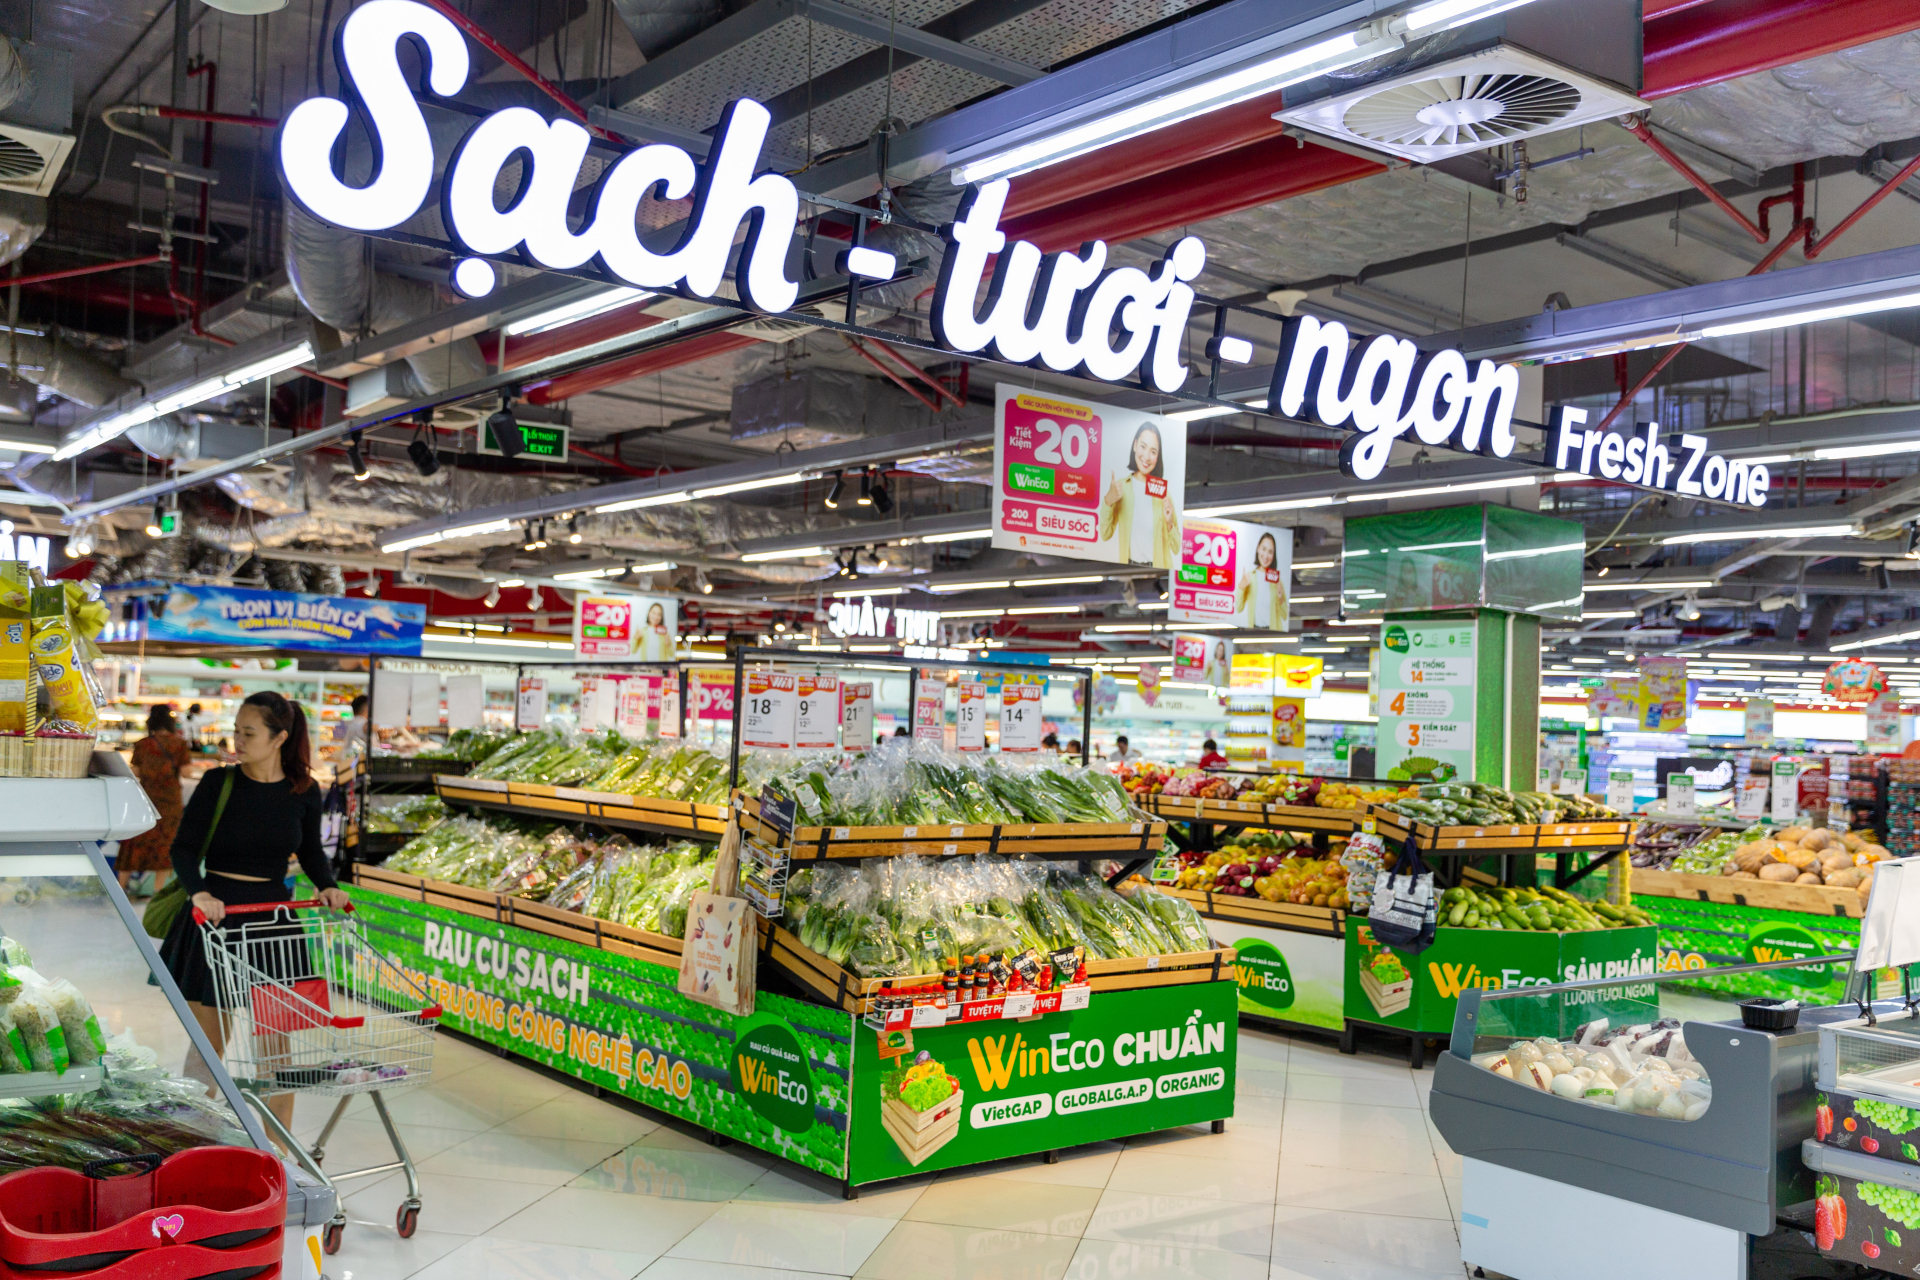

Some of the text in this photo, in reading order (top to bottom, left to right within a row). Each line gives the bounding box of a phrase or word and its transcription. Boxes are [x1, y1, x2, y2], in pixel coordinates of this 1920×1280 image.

[277, 0, 801, 313] Sạch
[938, 176, 1207, 394] tươi
[1277, 314, 1520, 482] ngon
[1014, 426, 1032, 439] Tiết
[529, 443, 555, 455] EXIT
[1009, 435, 1032, 450] Kiệm
[1554, 405, 1771, 507] Fresh Zone
[1014, 472, 1050, 490] WinEco
[1011, 508, 1029, 520] 200
[1041, 514, 1090, 533] SIÊU SỐC
[219, 599, 272, 619] TRỌN
[273, 599, 295, 620] VỊ
[5, 623, 25, 645] Tipo
[893, 607, 941, 646] THỊT
[1410, 670, 1424, 683] 14
[1390, 692, 1406, 716] 4
[1406, 690, 1429, 699] KHÔNG
[750, 698, 771, 715] 18
[800, 700, 809, 716] 9
[846, 707, 857, 721] 21
[961, 707, 973, 722] 15
[1006, 708, 1023, 722] 14
[1408, 724, 1420, 747] 3
[423, 920, 590, 1007] RAU CỦ SẠCH
[1563, 948, 1655, 983] SẢN PHẨM
[1231, 963, 1289, 992] WinEco
[1074, 996, 1083, 1004] 36
[1625, 982, 1656, 999] NGON
[915, 1007, 924, 1015] 16
[968, 1004, 993, 1017] TUYỆT
[1040, 997, 1058, 1010] VIỆT
[428, 975, 506, 1032] TRƯỜNG
[507, 1002, 566, 1055] CÔNG
[568, 1022, 633, 1091] NGHỆ
[635, 1047, 693, 1101] CAO
[750, 1041, 800, 1063] RAU CỦ QUẢ SẠCH
[967, 1009, 1225, 1092] WinEco CHUẨN
[738, 1053, 808, 1106] WinEco
[981, 1072, 1221, 1123] VietGAP GLOBALG.A.P ORGANIC
